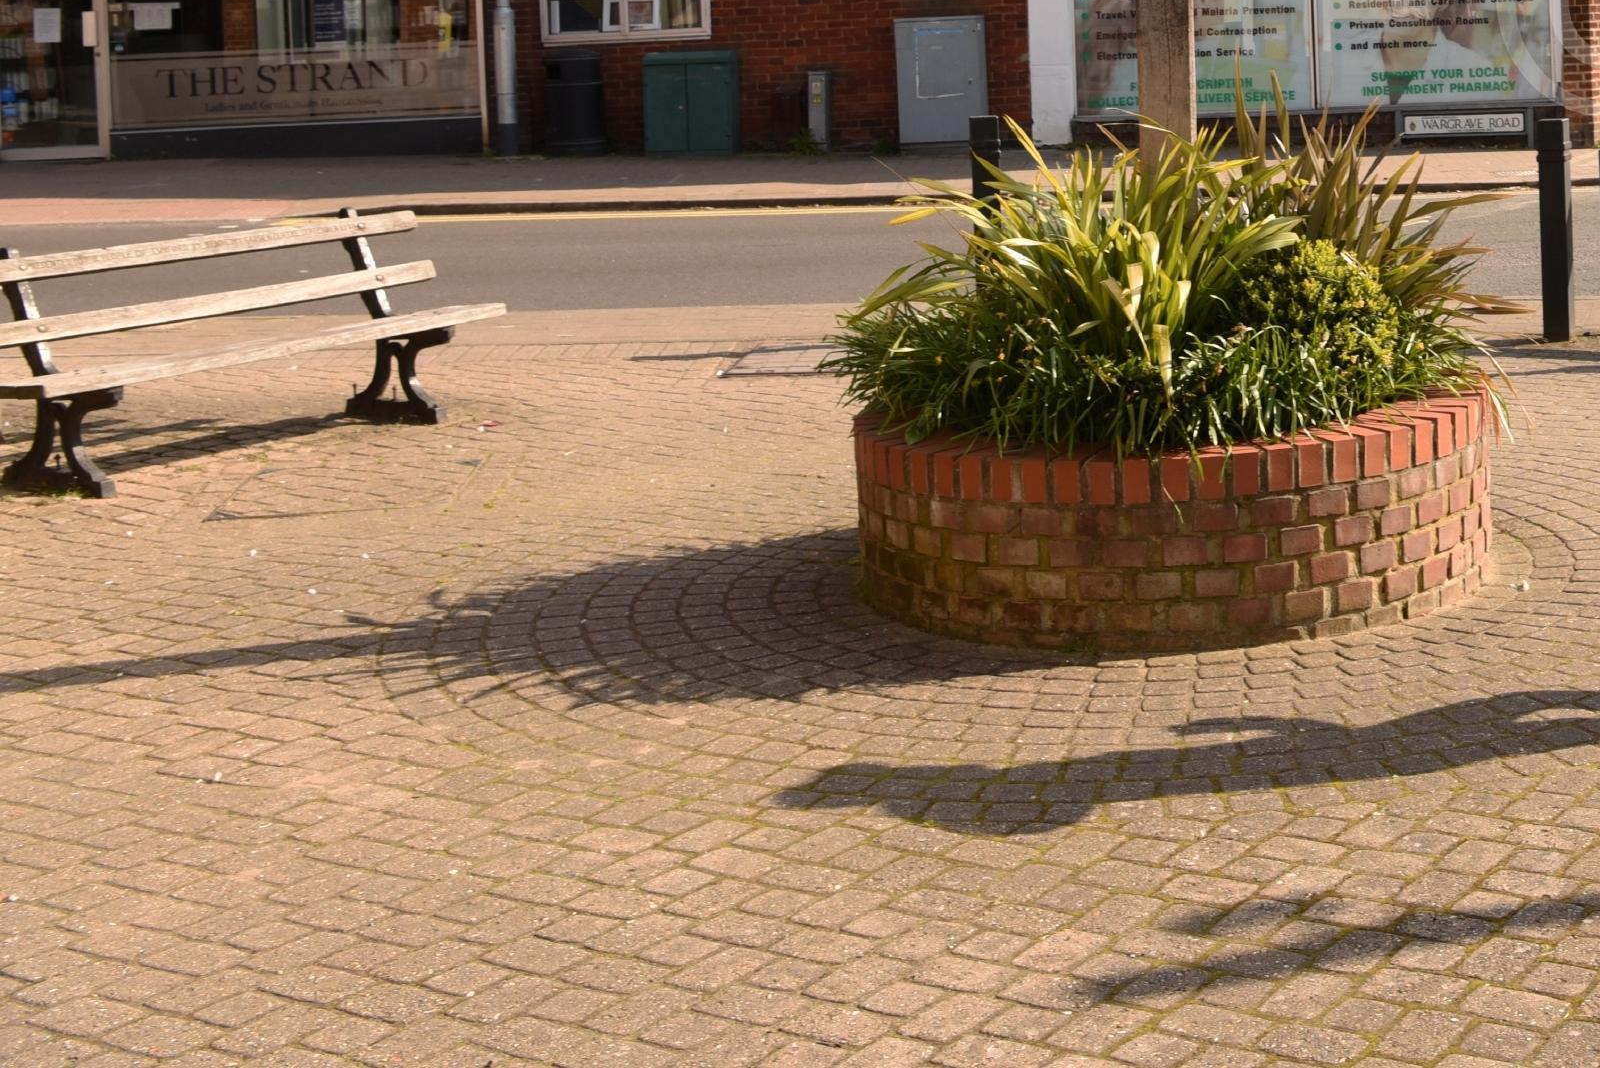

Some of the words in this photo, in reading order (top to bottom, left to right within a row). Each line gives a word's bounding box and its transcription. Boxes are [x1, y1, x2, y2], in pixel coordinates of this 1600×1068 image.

[1201, 7, 1238, 17] Malaria
[1242, 5, 1296, 15] Prevention
[1349, 19, 1384, 29] Private
[1388, 18, 1451, 28] Consultation
[1455, 16, 1489, 26] Rooms
[1350, 41, 1369, 50] and
[1372, 39, 1400, 50] much
[1403, 40, 1437, 49] more...
[156, 65, 246, 98] THE
[256, 59, 429, 94] STRAND
[1371, 70, 1426, 82] SUPPORT
[1431, 68, 1464, 80] YOUR
[1469, 66, 1508, 78] LOCAL
[1450, 80, 1517, 93] PHARMACY
[1421, 118, 1485, 130] WARGRAVE
[1488, 117, 1521, 128] ROAD
